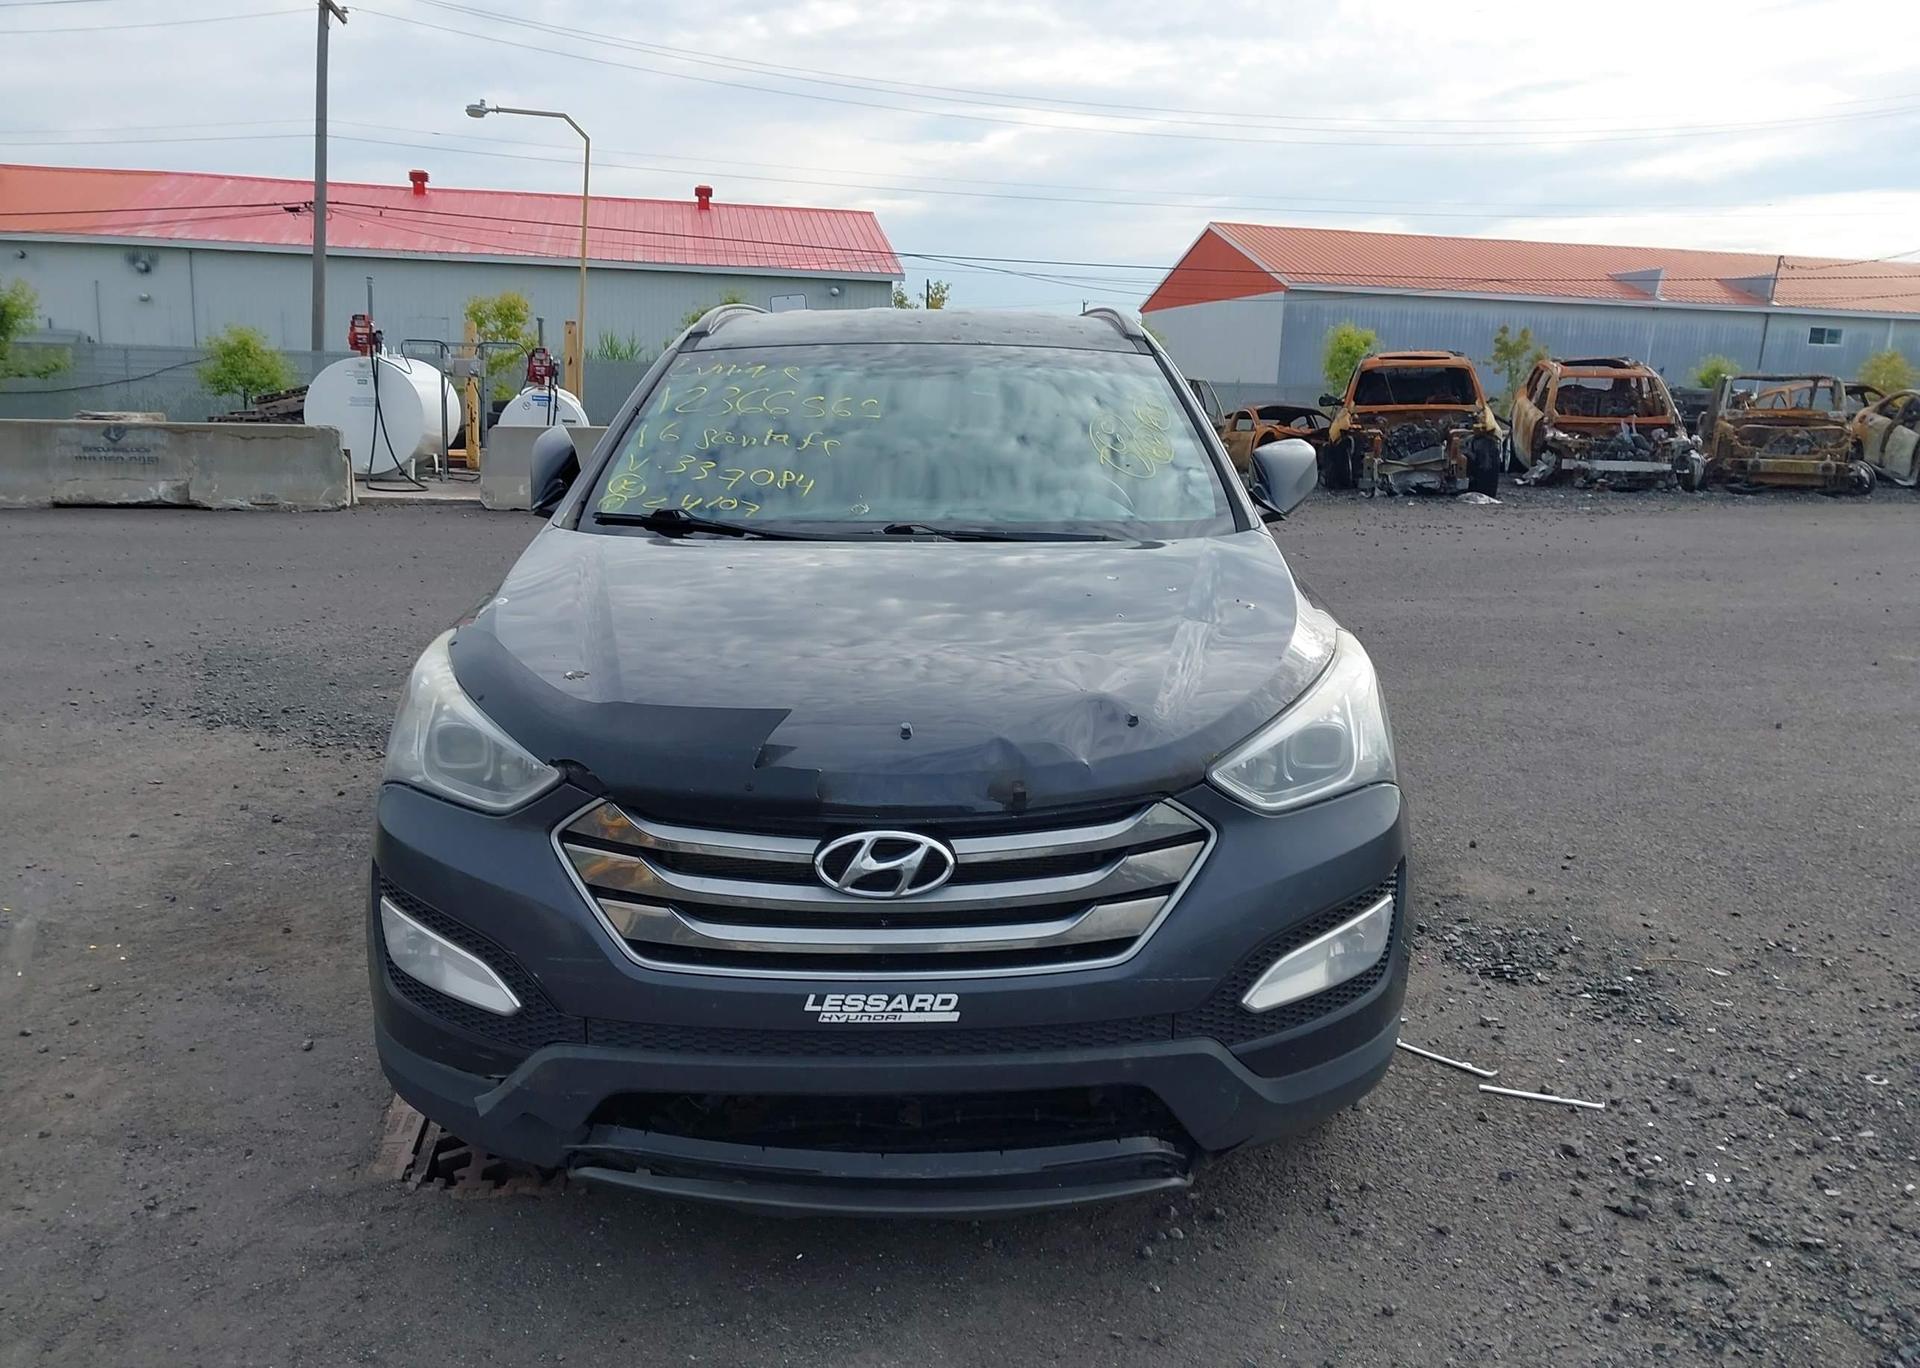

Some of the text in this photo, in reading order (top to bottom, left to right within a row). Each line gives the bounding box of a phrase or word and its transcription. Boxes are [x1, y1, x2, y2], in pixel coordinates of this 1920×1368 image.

[638, 422, 681, 448] 16
[803, 993, 960, 1012] LESSARD
[818, 1013, 903, 1023] HYUNDAI
